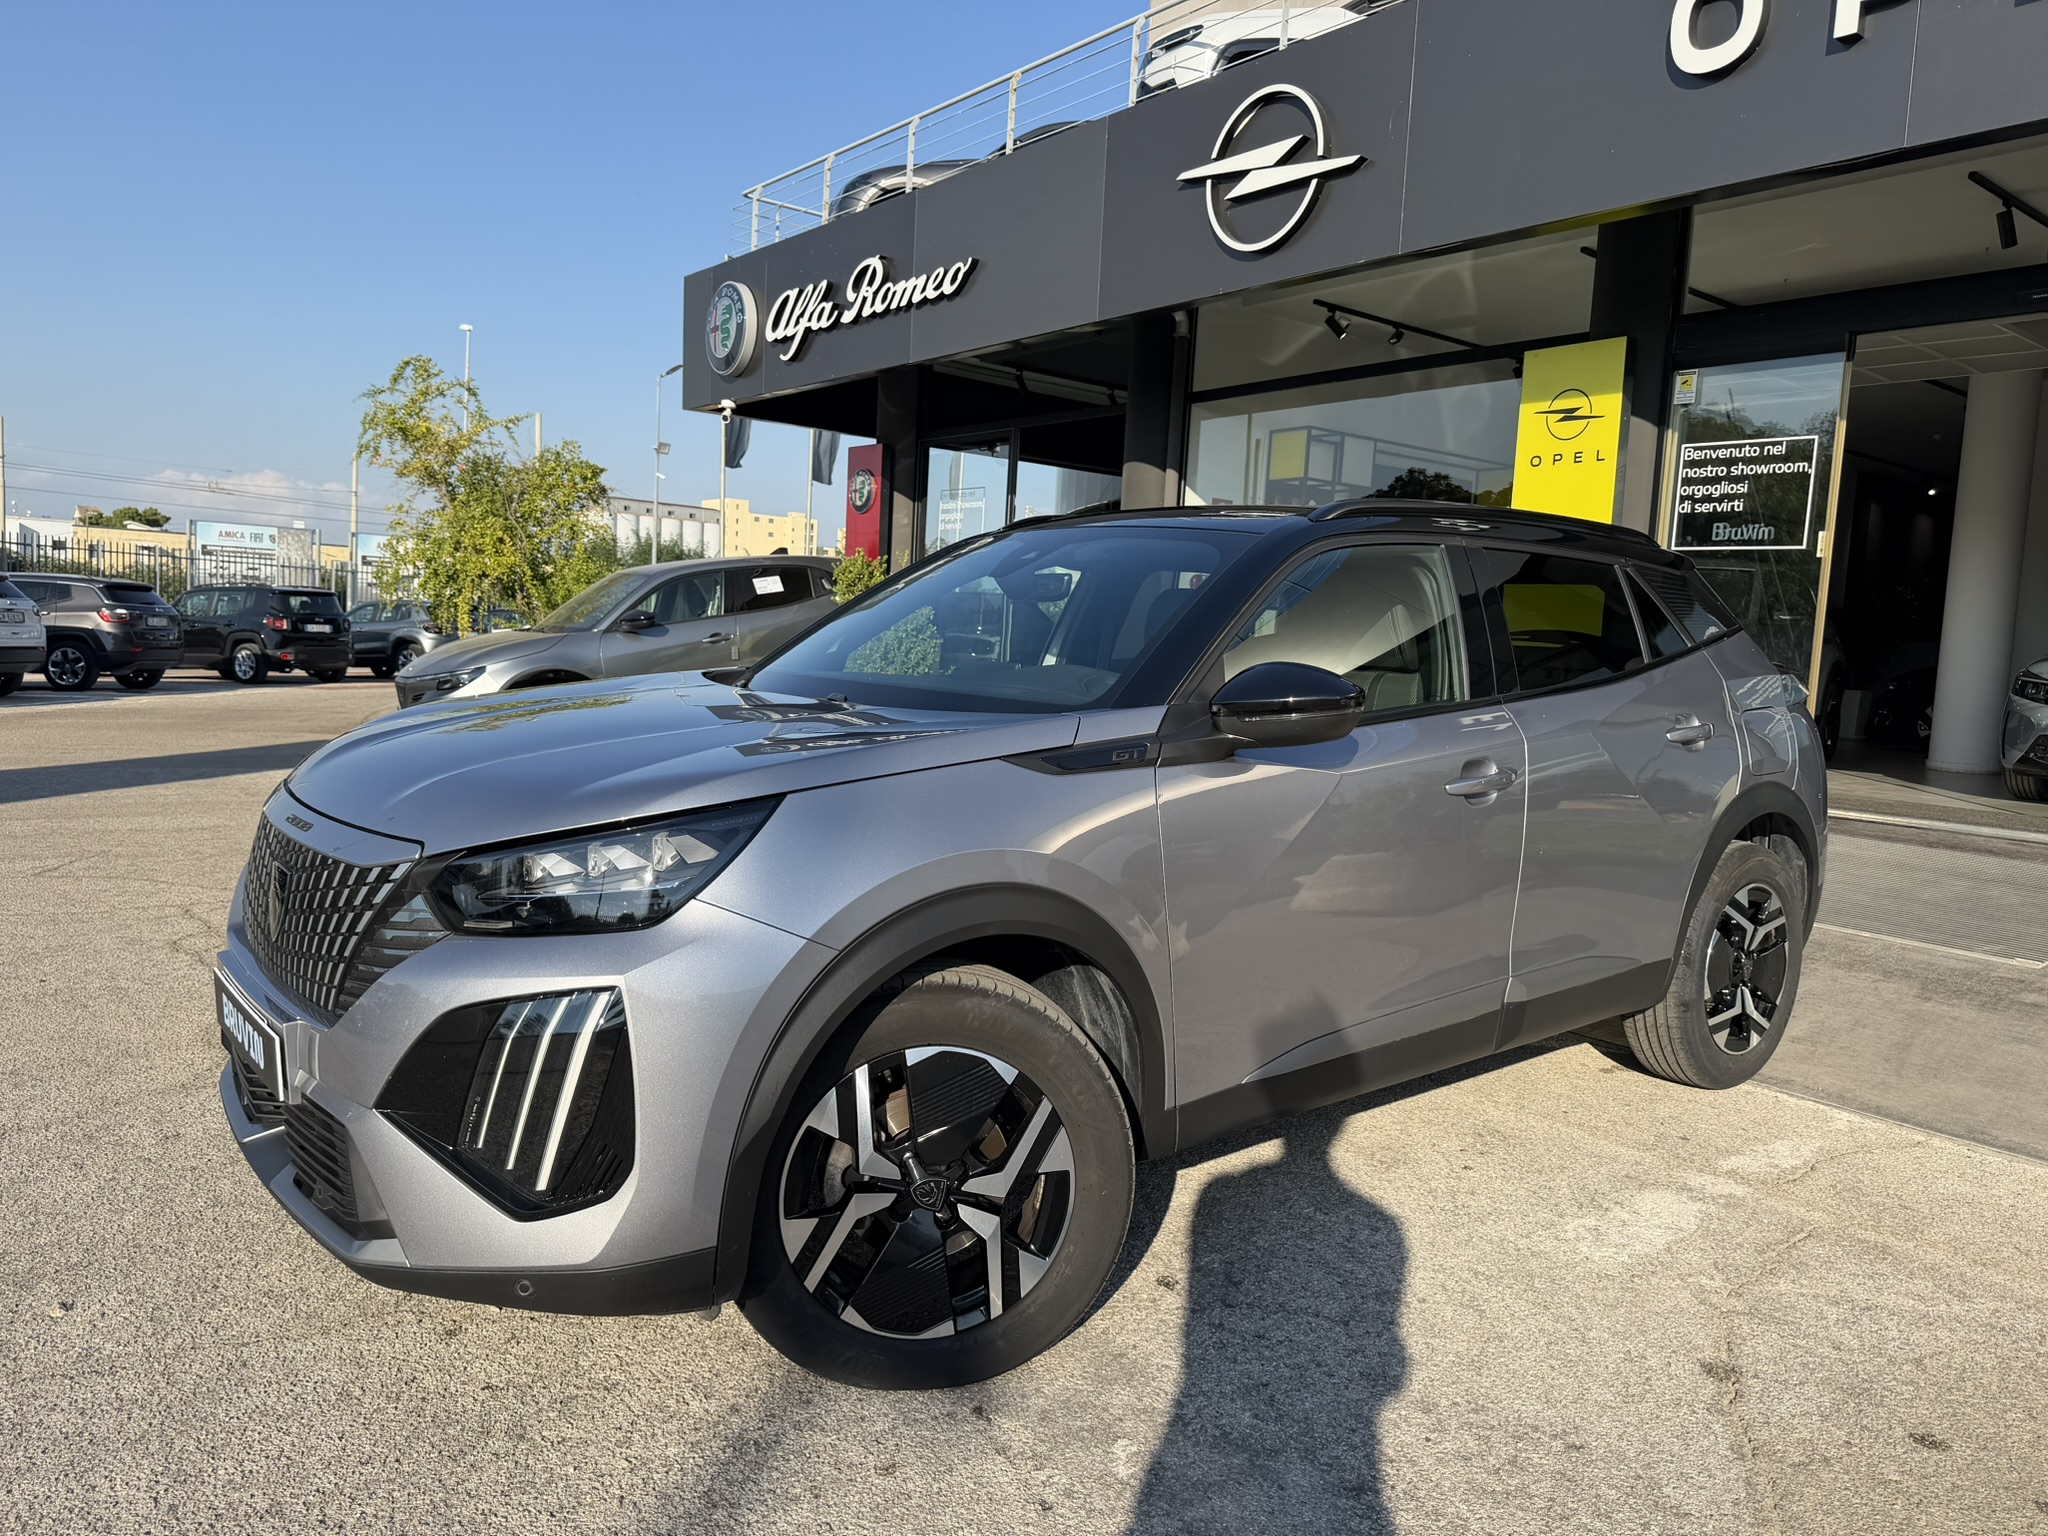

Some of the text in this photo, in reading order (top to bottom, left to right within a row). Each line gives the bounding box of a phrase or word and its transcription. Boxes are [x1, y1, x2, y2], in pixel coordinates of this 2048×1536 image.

[765, 279, 838, 361] Alfa
[841, 255, 974, 324] Romeo
[1530, 450, 1605, 467] OPEL
[1684, 441, 1787, 461] Benvenuto nel
[1682, 462, 1812, 478] nostro showroom,
[1680, 481, 1749, 498] orgogliosi
[1678, 499, 1744, 514] di servirti
[218, 530, 264, 543] AMICA FIAT
[1112, 747, 1144, 761] GT
